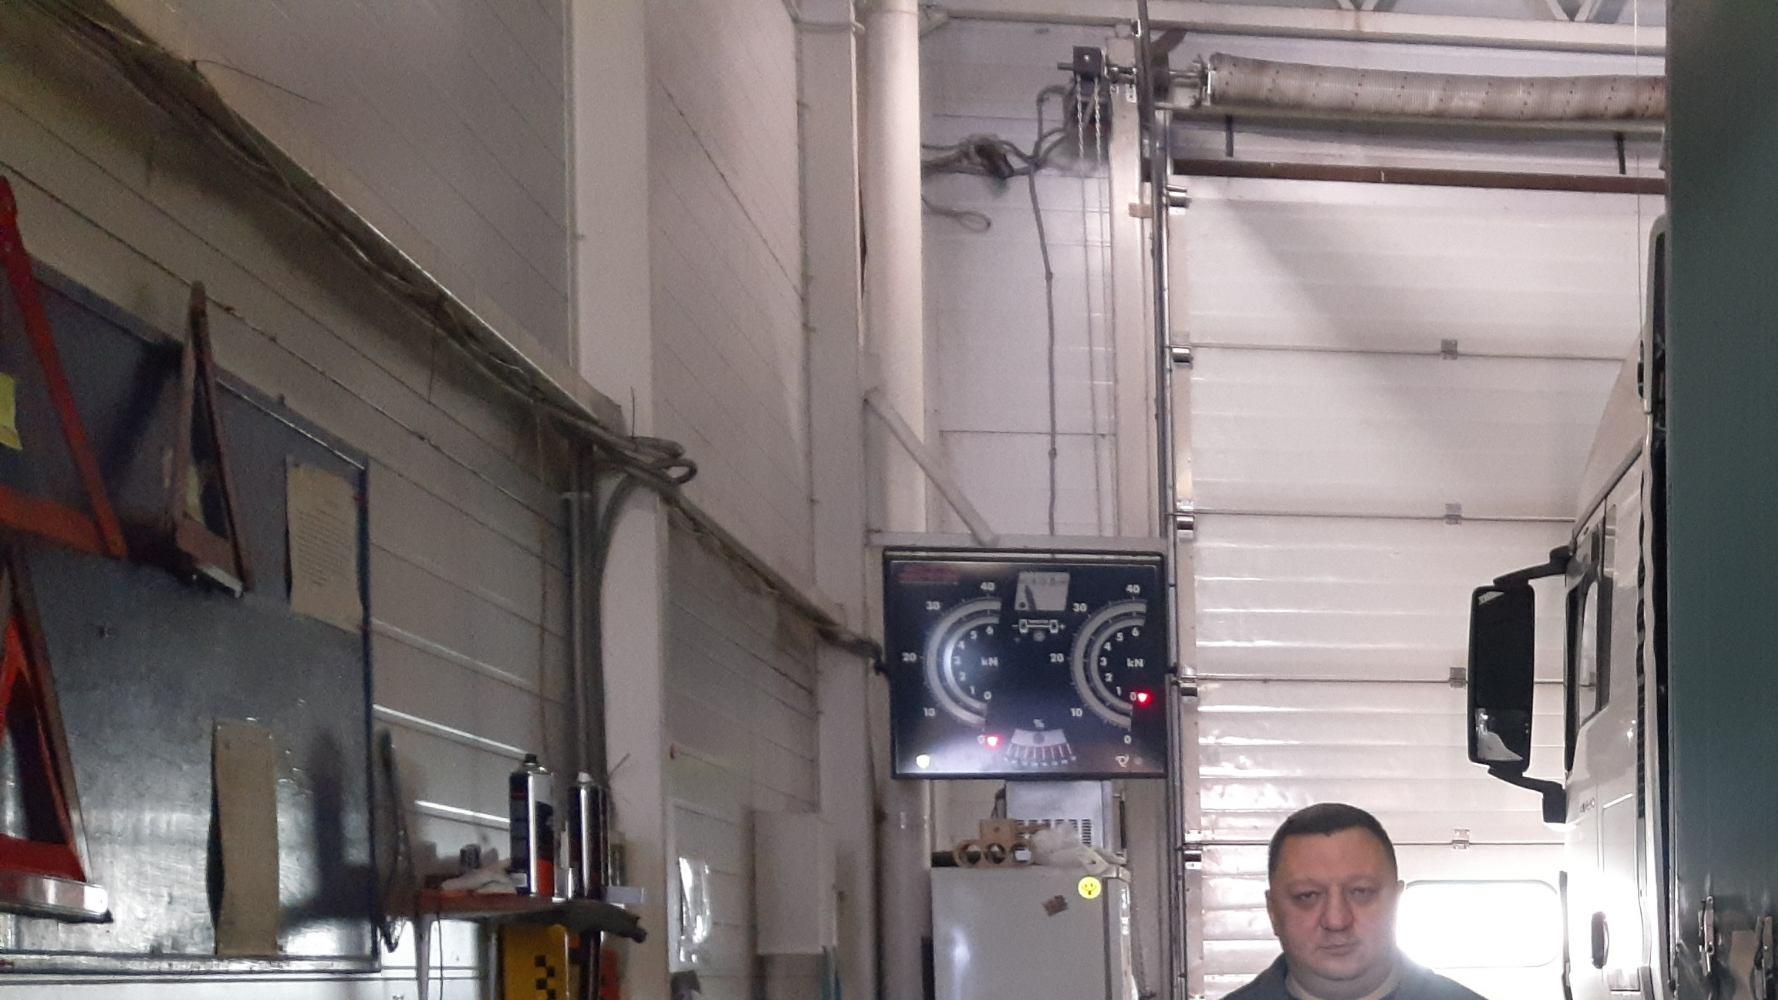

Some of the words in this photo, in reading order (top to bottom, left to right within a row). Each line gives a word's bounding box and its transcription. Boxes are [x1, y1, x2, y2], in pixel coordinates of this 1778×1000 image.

[1073, 603, 1087, 612] 30
[1115, 632, 1124, 642] 5
[1132, 628, 1140, 637] 6
[1103, 642, 1112, 651] 4
[1050, 653, 1064, 662] 20
[1100, 656, 1108, 666] 3
[1104, 673, 1113, 682] 2
[983, 691, 992, 700] 0
[1115, 686, 1122, 696] 1
[1070, 708, 1083, 717] 10
[1123, 735, 1132, 744] 0
